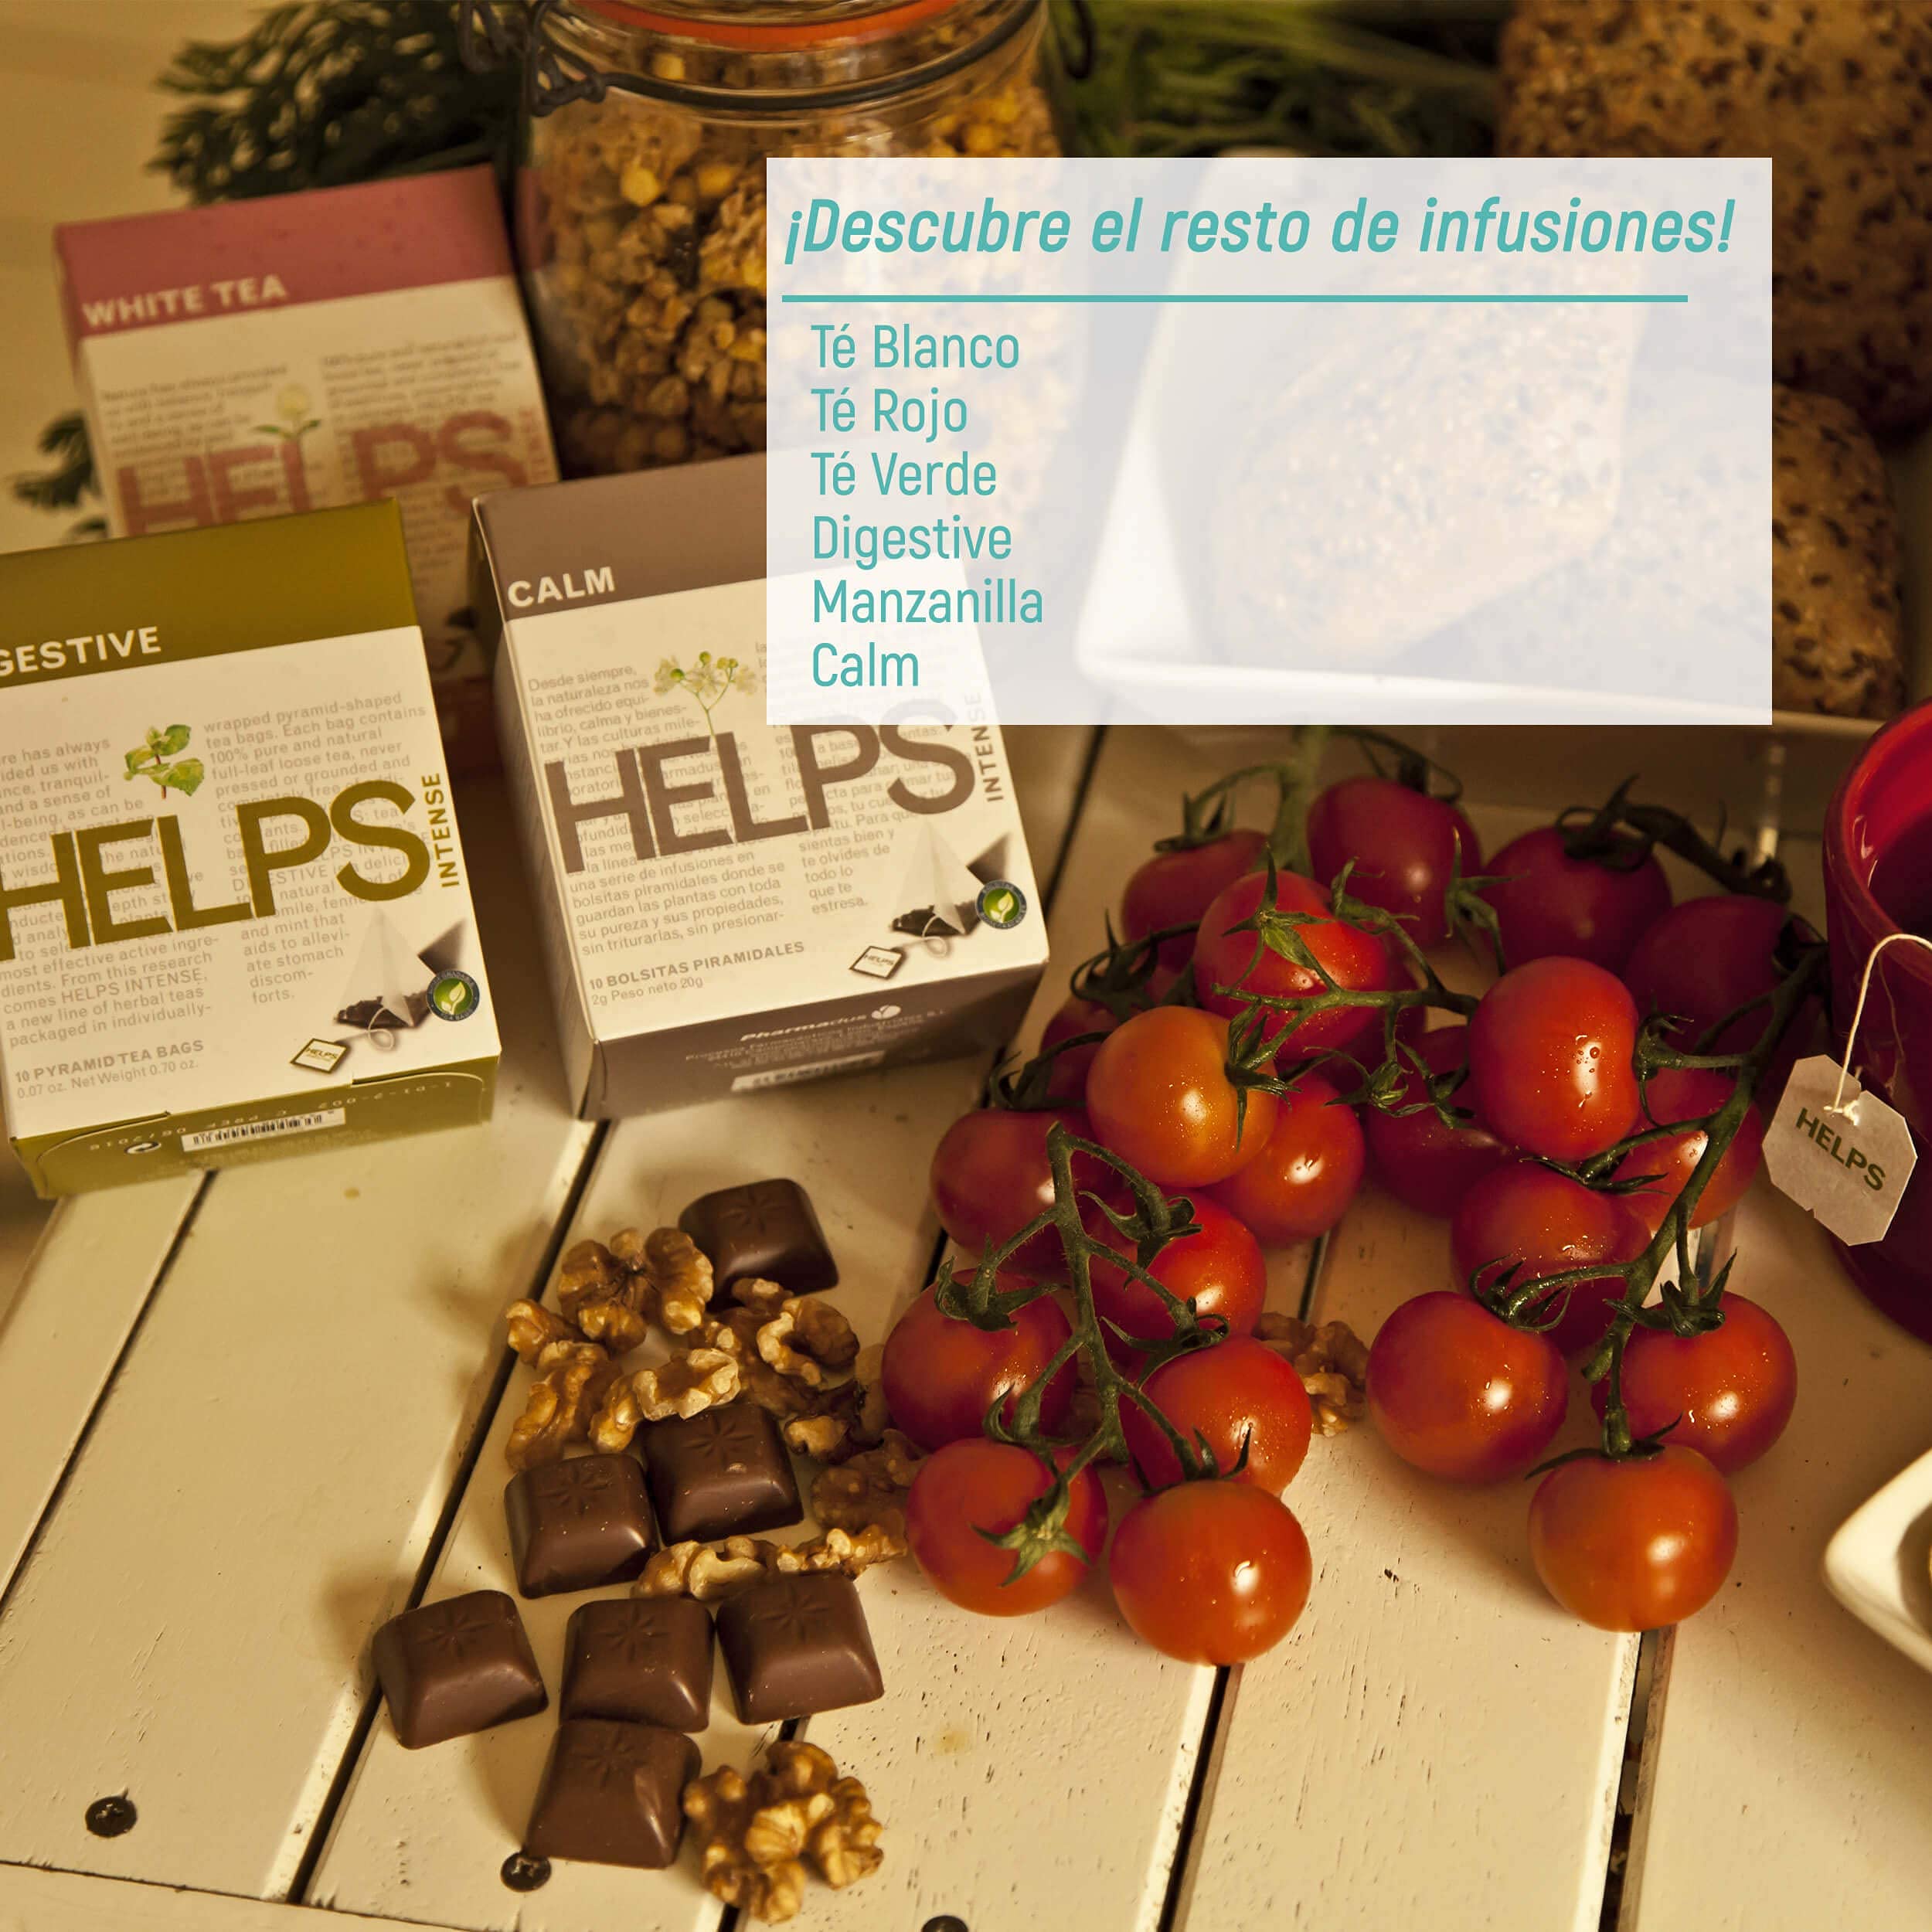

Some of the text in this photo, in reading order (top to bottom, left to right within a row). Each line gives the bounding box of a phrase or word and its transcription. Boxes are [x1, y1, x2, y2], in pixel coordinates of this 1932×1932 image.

[82, 275, 286, 327] WHITE TEA
[508, 566, 615, 609] CALM
[0, 626, 162, 677] GESTIVE
[528, 665, 637, 692] Desde siempre,
[532, 678, 650, 708] la naturaleza nos
[204, 692, 403, 733] wrapped pyramid-shaped
[535, 694, 650, 723] ha ofrecido equi-
[580, 714, 621, 731] calma
[624, 713, 631, 725] y
[635, 704, 687, 721] bienes-
[206, 705, 427, 749] tea bags. Each bag contains
[564, 737, 574, 749] Y
[579, 733, 599, 747] las
[603, 723, 661, 743] culturas
[664, 716, 701, 731] mile-
[22, 738, 110, 761] has always
[210, 726, 383, 764] 100% pure and natural
[40, 756, 98, 774] us with
[212, 742, 403, 781] full-leaf loose tea, never
[216, 755, 411, 799] pressed or grounded and
[29, 785, 111, 811] a sense of
[40, 773, 110, 792] tranquil-
[310, 784, 341, 798] free
[545, 698, 975, 874] HELPS
[850, 784, 883, 798] para
[67, 797, 144, 821] as can be
[855, 813, 889, 826] Para
[421, 773, 459, 888] INTENSE
[798, 828, 895, 852] sientas bien y
[0, 780, 431, 961] HELPS
[801, 842, 890, 868] te olvides de
[570, 850, 754, 893] una serie de infusiones en
[572, 862, 785, 909] bolsitas piramidales donde se
[804, 864, 853, 883] todo lo
[280, 881, 335, 900] natural
[576, 877, 781, 927] guardan las plantas con toda
[808, 882, 852, 900] que te
[811, 897, 869, 914] estresa.
[240, 913, 345, 940] and mint that
[579, 895, 784, 940] su pureza y sus propiedades,
[243, 931, 350, 957] aids to allevi-
[582, 911, 784, 957] sin triturarlas, sin presionar-
[43, 936, 219, 973] effective active ingre-
[61, 971, 101, 988] From
[107, 964, 137, 979] this
[142, 952, 213, 974] research
[247, 947, 344, 972] ate stomach
[590, 941, 805, 991] 10 BOLSITAS PIRAMIDALES
[249, 970, 315, 988] discom-
[592, 975, 704, 1007] 2g Peso neto 20g
[3, 996, 56, 1014] comes
[61, 982, 120, 1004] HELPS
[6, 986, 205, 1030] a new line of herbal teas
[253, 988, 295, 1005] forts.
[9, 1001, 212, 1049] packaged in individually-
[15, 1039, 205, 1083] 10 PYRAMID TEA BAGS
[305, 1047, 338, 1060] HELPS
[17, 1061, 176, 1099] 0.07 Net Weight 0.70
[1795, 1107, 1886, 1191] HELPS
